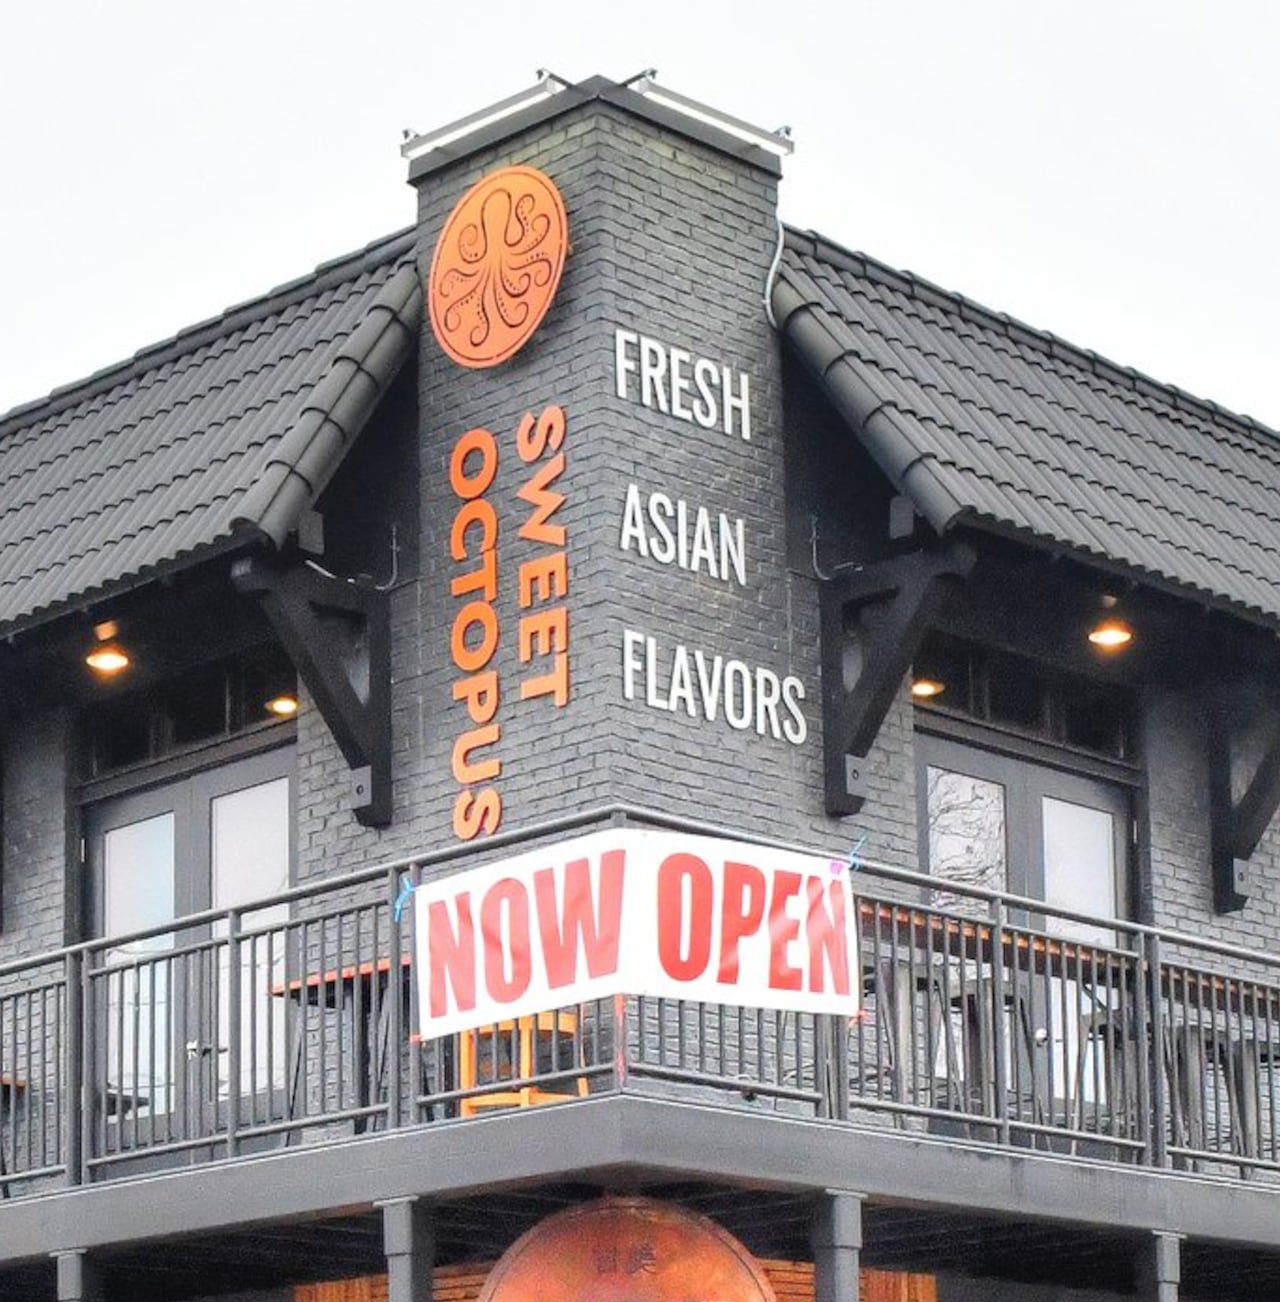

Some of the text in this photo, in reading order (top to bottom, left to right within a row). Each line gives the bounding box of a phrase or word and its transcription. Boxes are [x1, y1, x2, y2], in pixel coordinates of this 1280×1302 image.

[615, 329, 751, 441] FRESH
[516, 405, 569, 707] SWEET
[620, 483, 747, 586] ASIAN
[449, 428, 503, 841] OCTOPUS
[621, 629, 808, 746] FLAVORS
[428, 848, 850, 1019] NOW OPEN
